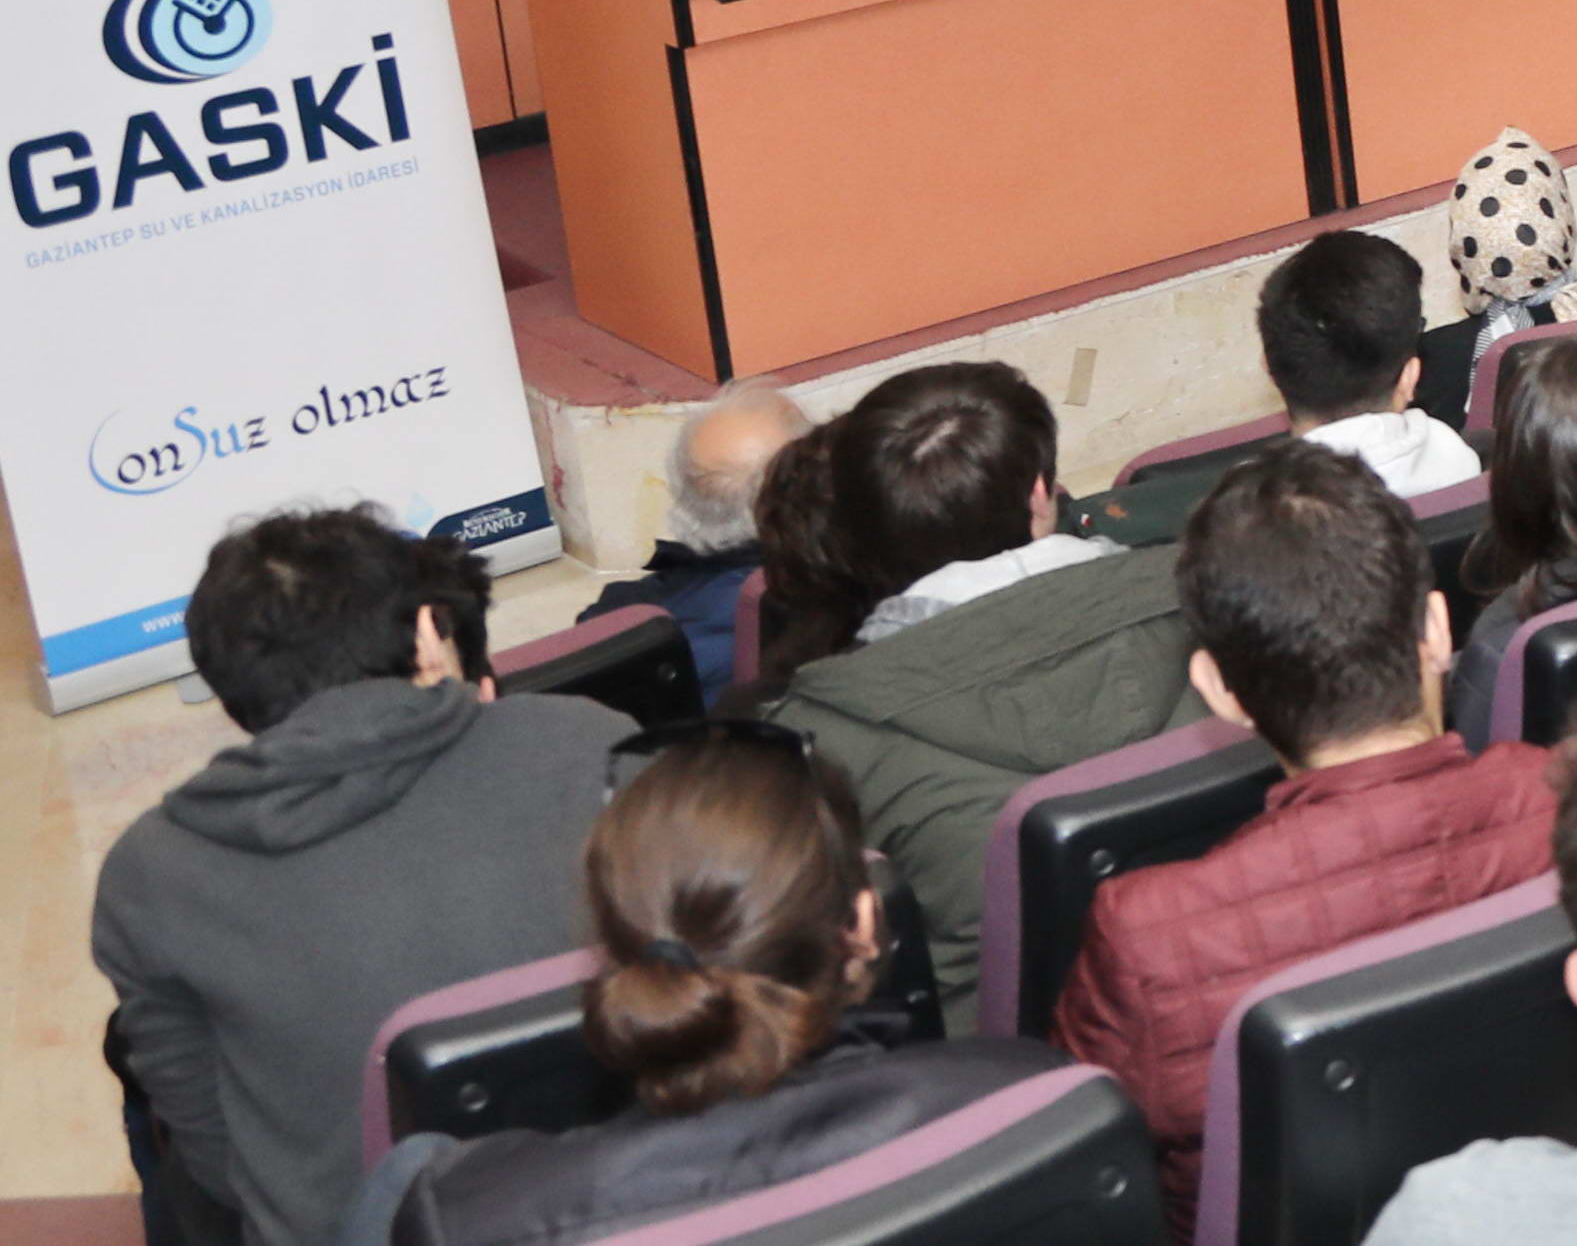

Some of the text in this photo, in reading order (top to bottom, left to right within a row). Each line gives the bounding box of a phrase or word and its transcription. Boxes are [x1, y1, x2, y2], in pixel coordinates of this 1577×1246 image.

[8, 32, 412, 230] GASKİ
[26, 156, 421, 269] GAZİANTEP SU VE KANALİZASYON İDARESİ
[292, 365, 452, 436] olmaz
